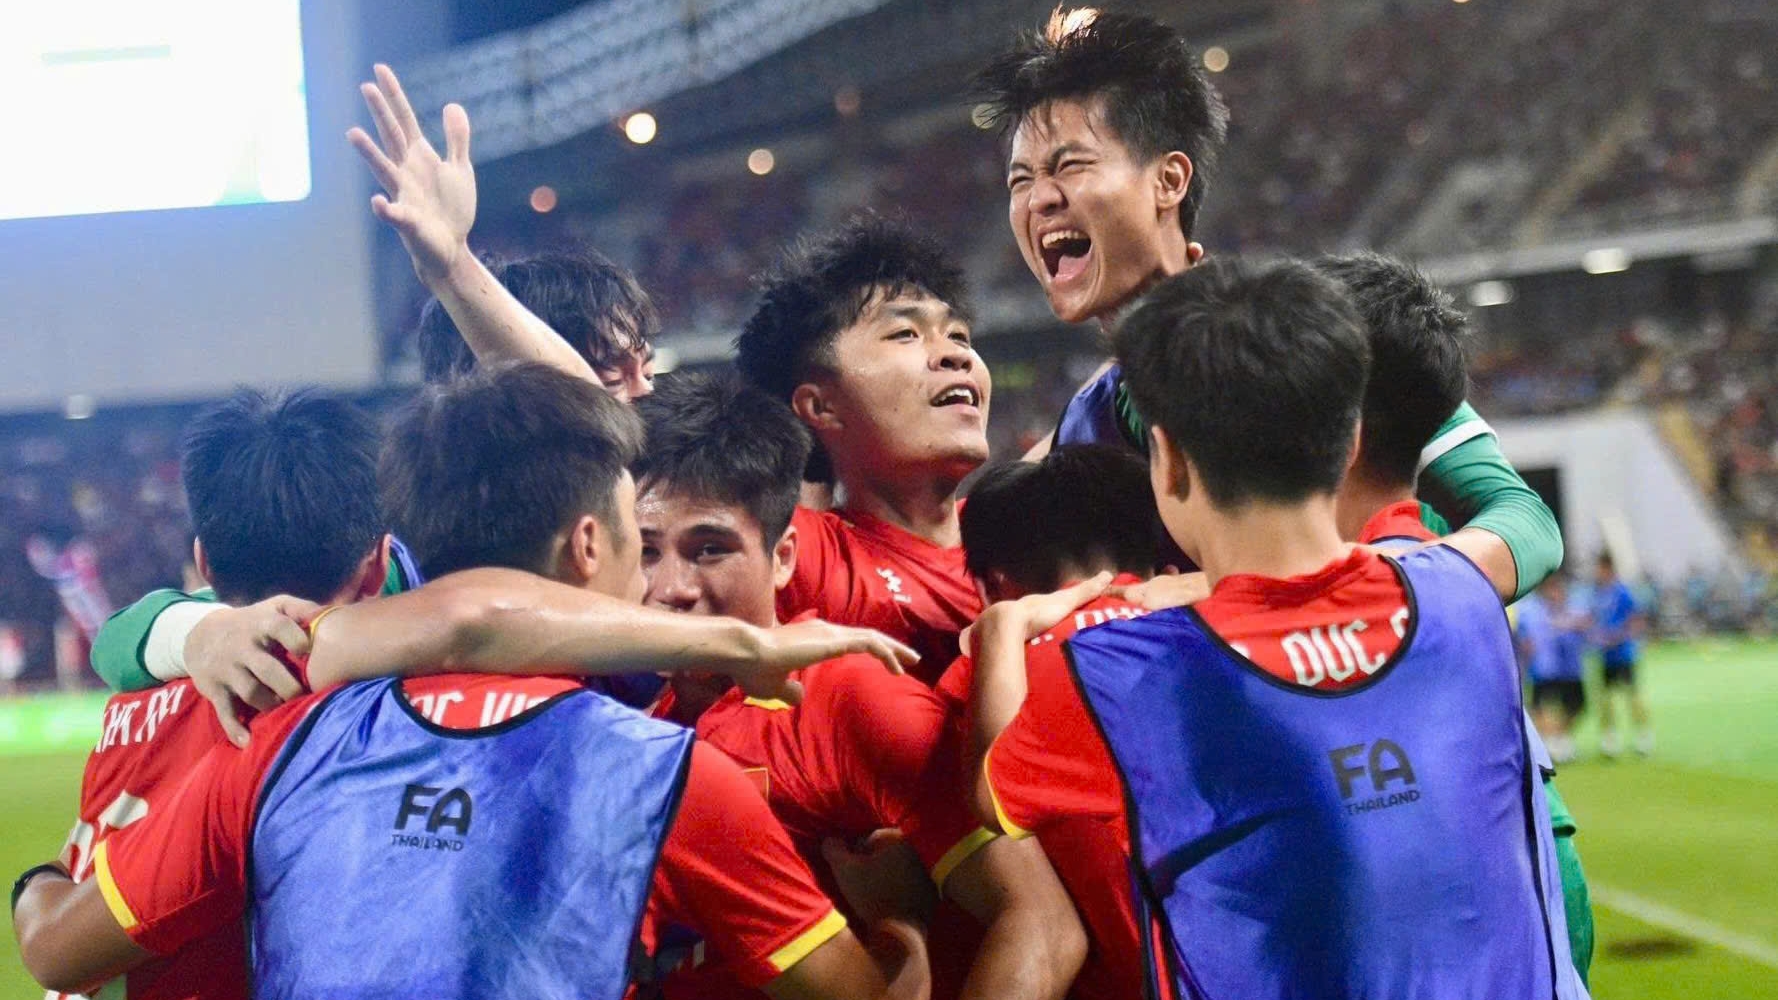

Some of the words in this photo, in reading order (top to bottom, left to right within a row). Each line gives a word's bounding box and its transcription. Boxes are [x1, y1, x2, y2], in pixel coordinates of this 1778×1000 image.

[1280, 618, 1387, 687] DUC
[1328, 738, 1416, 799] FA
[394, 784, 472, 836] FA
[1344, 789, 1420, 815] THAILAND
[391, 834, 464, 852] THAILAND
